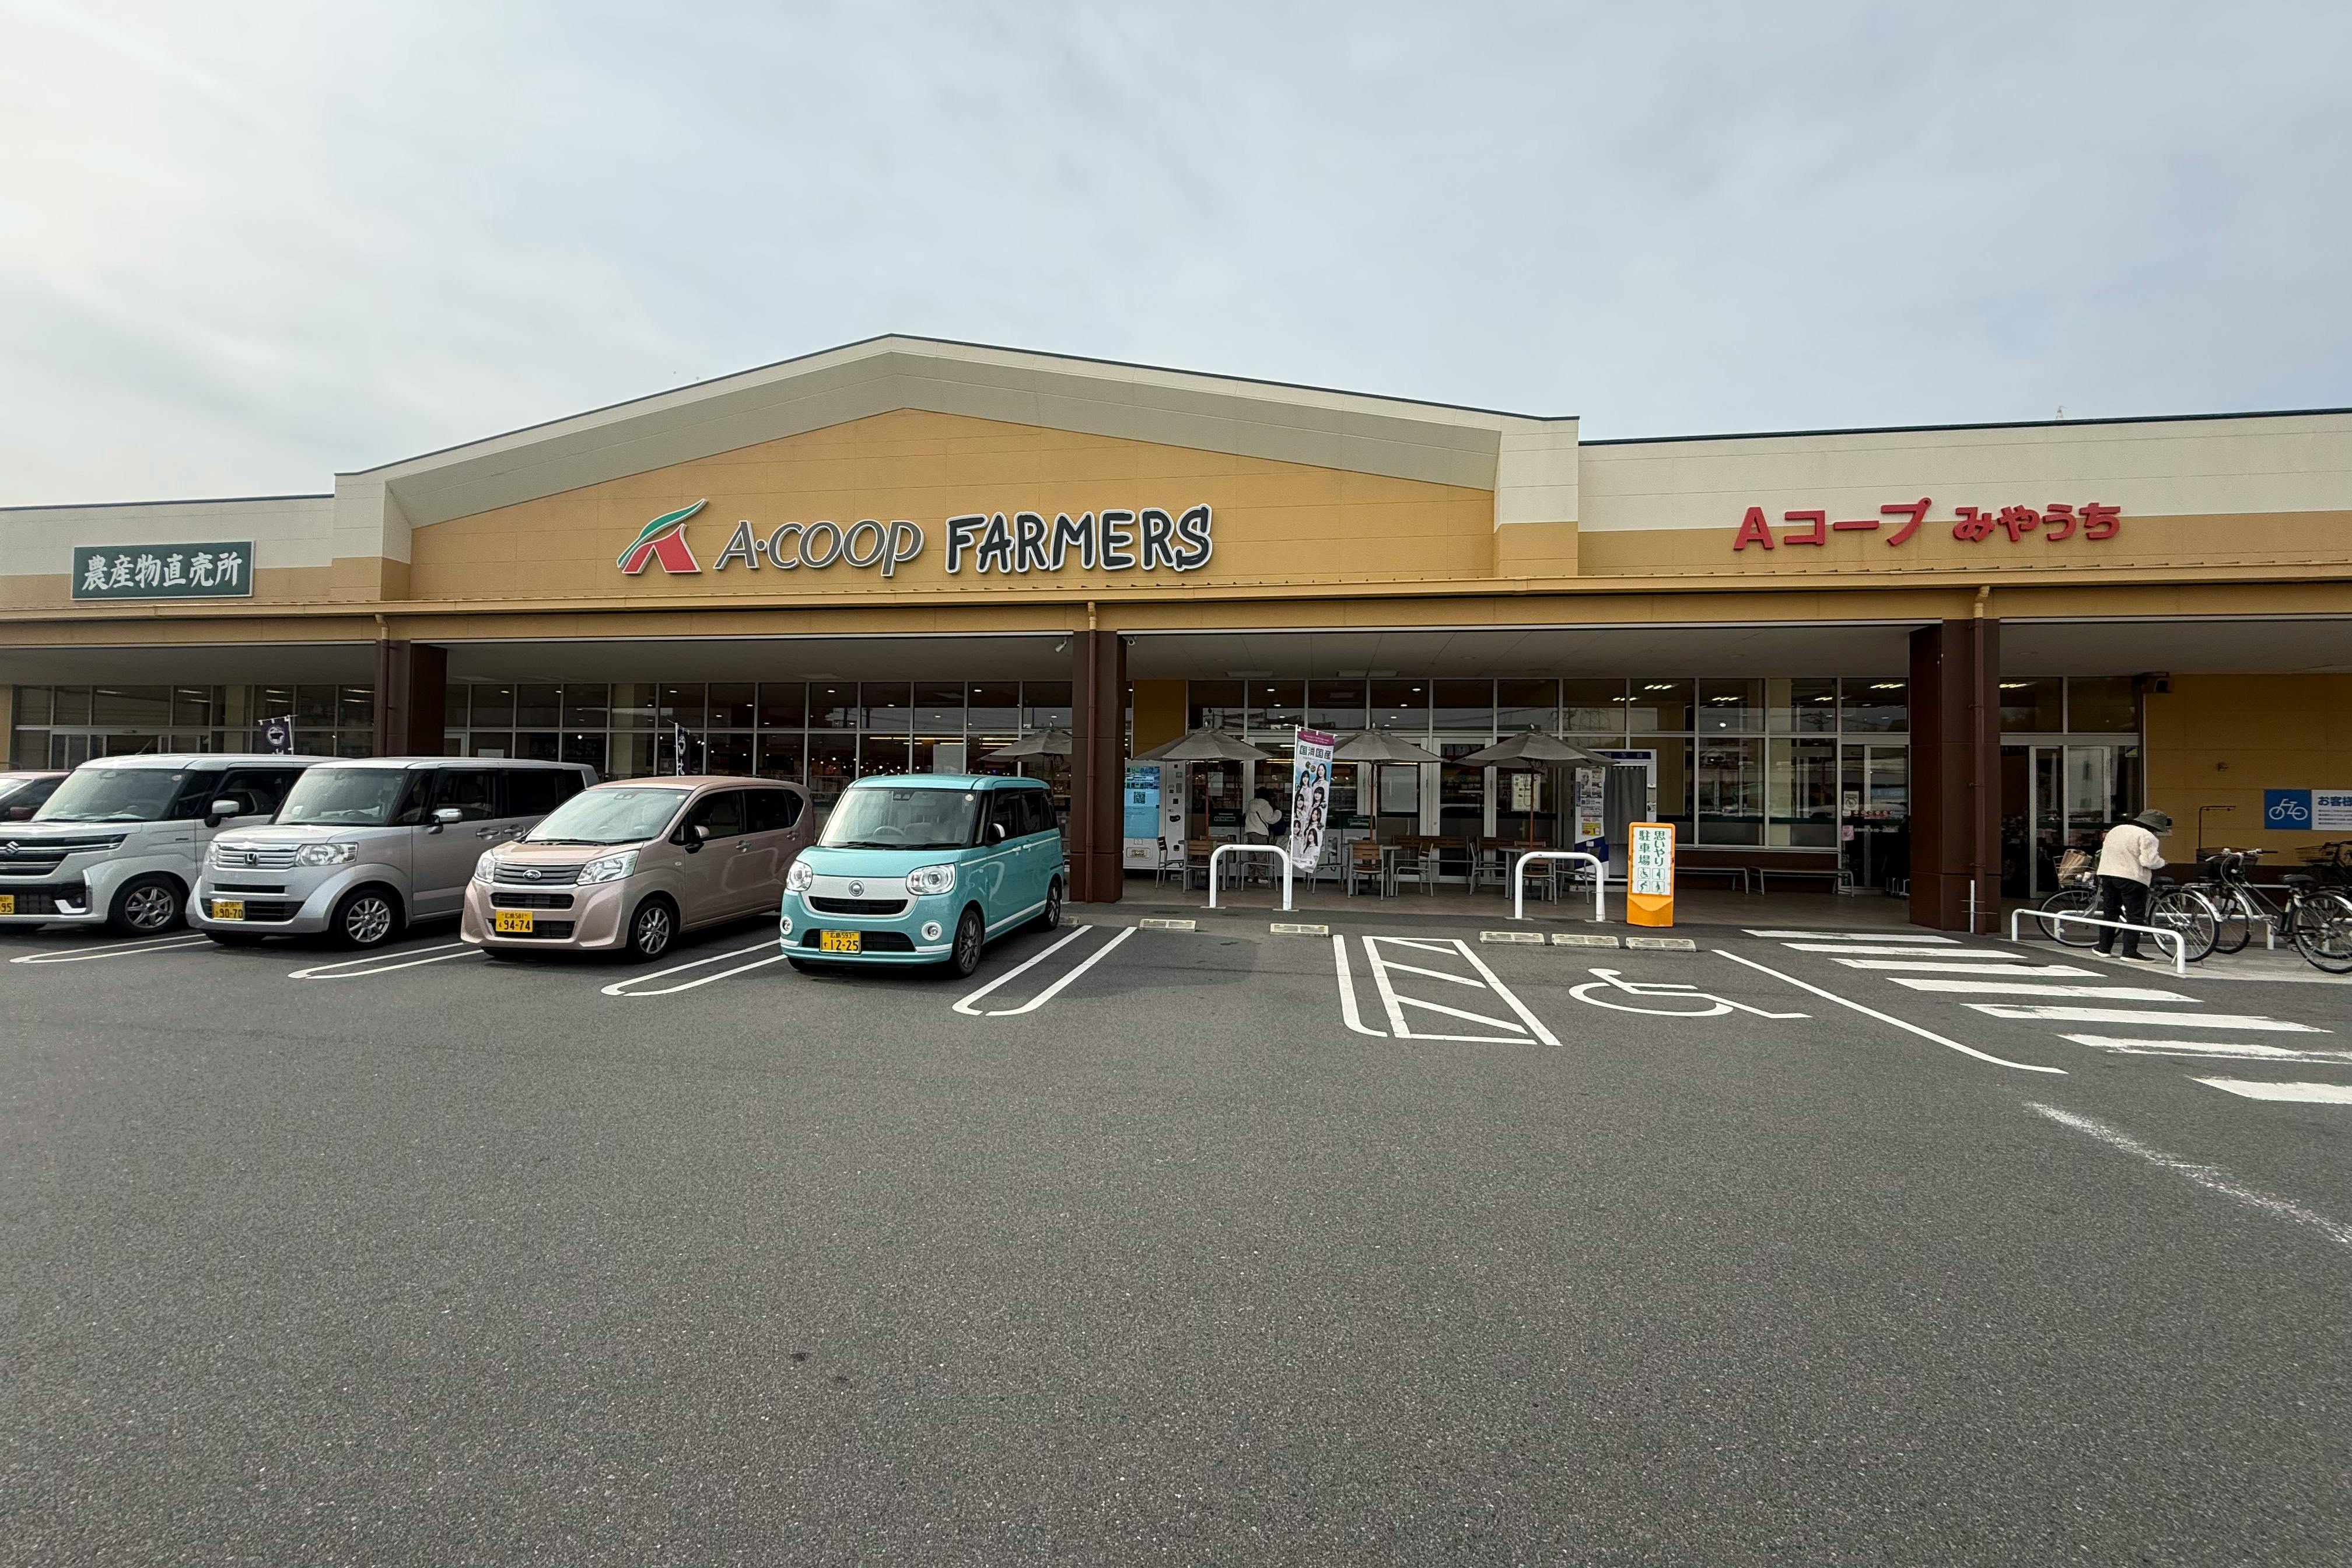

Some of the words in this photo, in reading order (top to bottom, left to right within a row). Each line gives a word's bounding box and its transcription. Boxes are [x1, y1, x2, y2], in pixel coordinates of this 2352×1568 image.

[945, 503, 1212, 573] FARMERS
[1733, 497, 1931, 550] Aコープ
[1953, 502, 2121, 542] みやうち
[82, 551, 243, 590] 農産物直売所
[1638, 830, 1650, 866] 駐車場
[1654, 831, 1665, 866] 思いやり
[219, 908, 243, 918] 90-70
[504, 920, 530, 930] 94-74
[831, 940, 859, 951] 12-25
